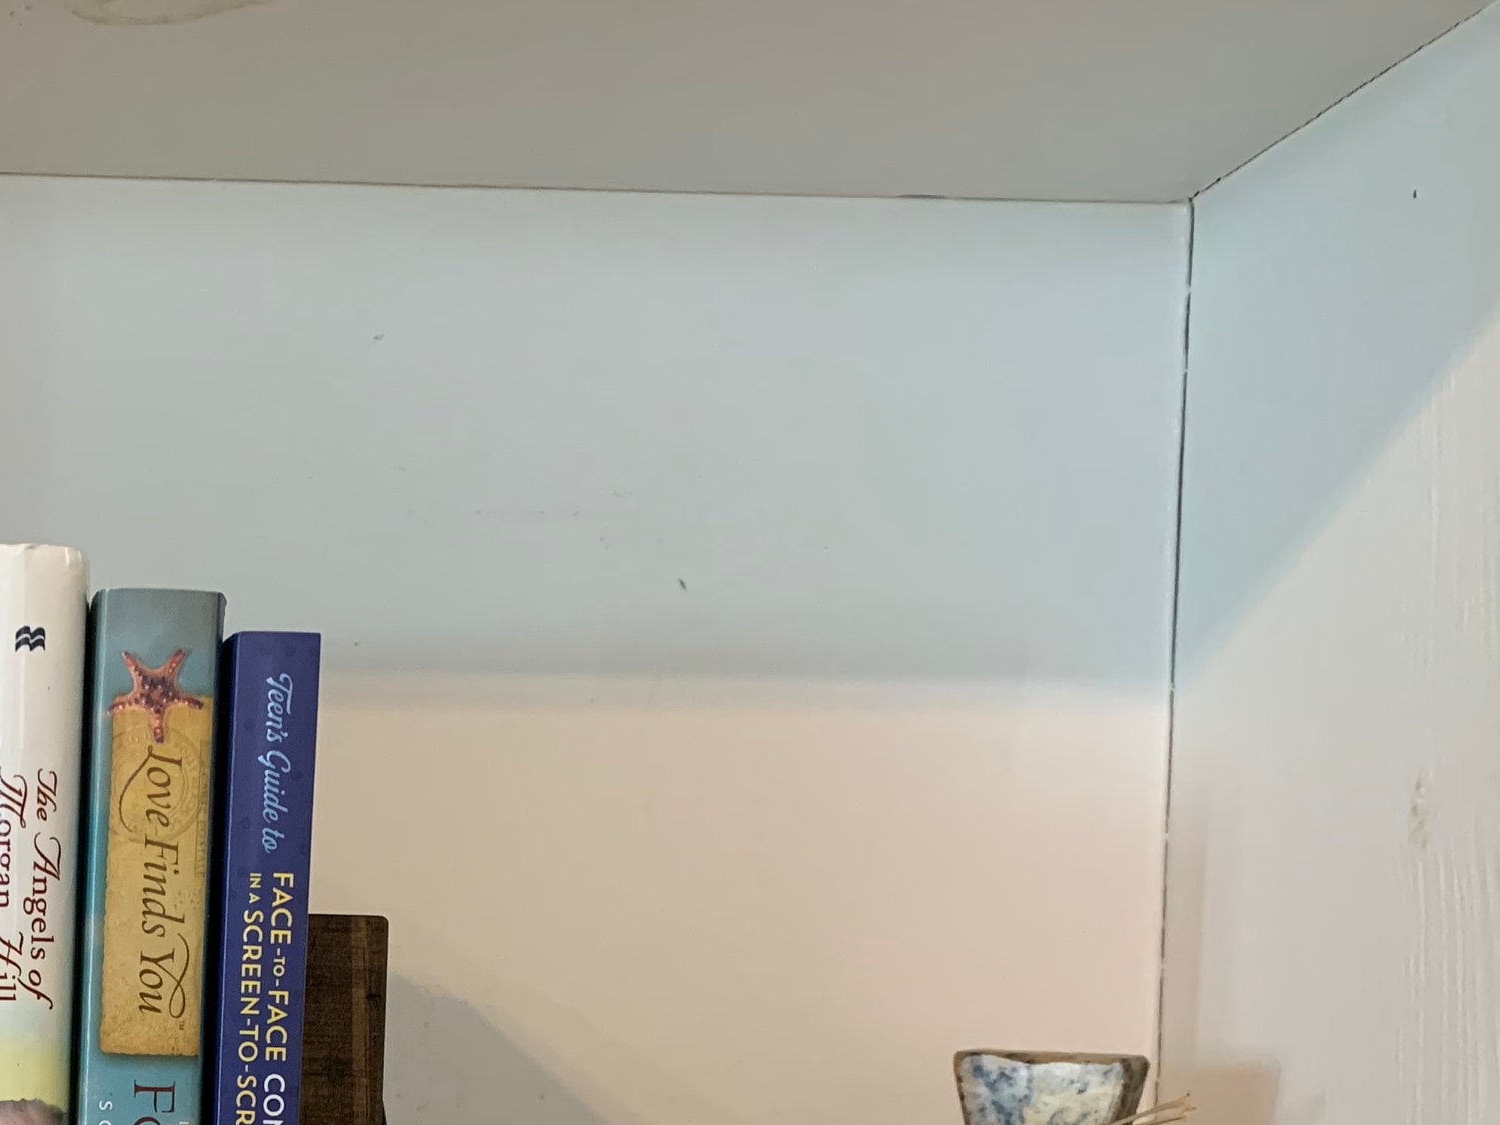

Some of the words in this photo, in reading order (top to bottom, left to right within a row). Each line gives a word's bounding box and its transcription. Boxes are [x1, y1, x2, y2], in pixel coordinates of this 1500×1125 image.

[264, 673, 294, 745] Teen's
[34, 768, 58, 822] The
[118, 744, 184, 832] Love
[258, 745, 292, 831] Guide
[248, 872, 262, 889] IN
[261, 833, 286, 854] to
[22, 834, 62, 961] Angels
[139, 834, 181, 938] Finds
[247, 892, 260, 905] A
[26, 968, 53, 1009] of
[138, 932, 190, 1019] You
[264, 871, 295, 1062] FACE-TO-FACE
